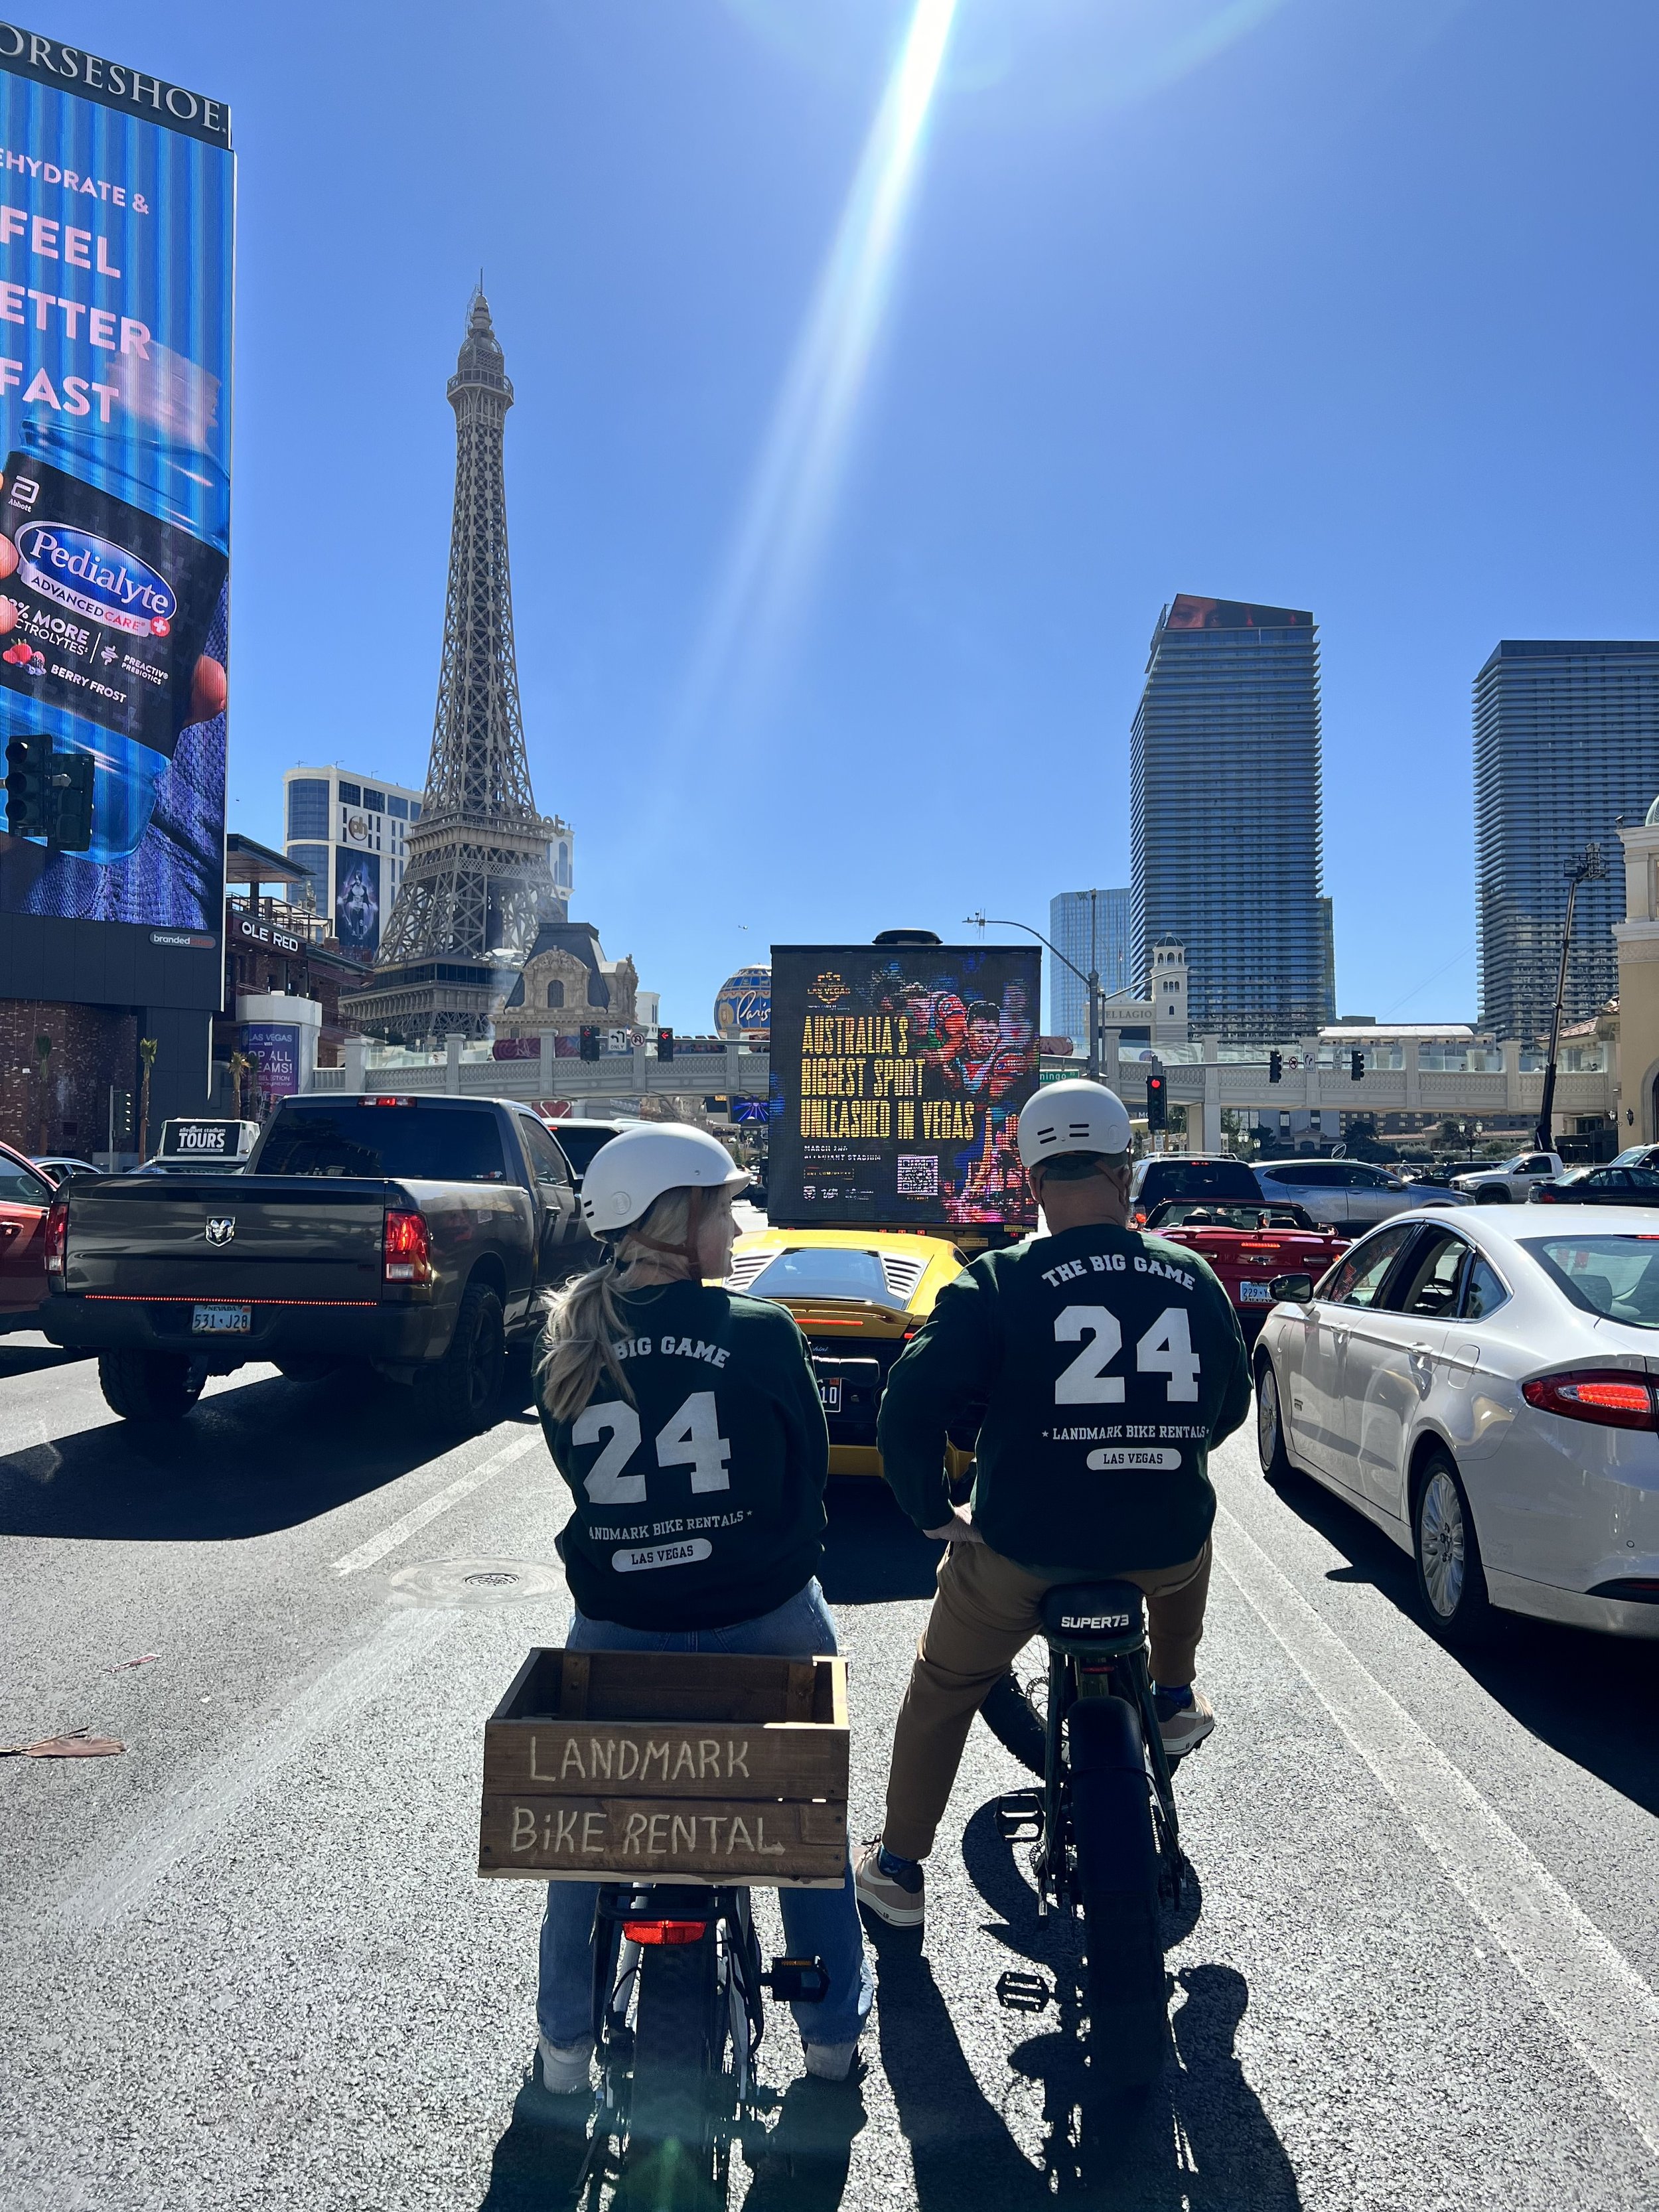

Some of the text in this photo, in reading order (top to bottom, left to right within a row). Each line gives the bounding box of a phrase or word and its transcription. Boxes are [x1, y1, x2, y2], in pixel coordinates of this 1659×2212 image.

[0, 148, 149, 214] HYDRATE &
[0, 204, 121, 279] FEEL
[0, 280, 151, 360] ETTER
[0, 357, 119, 423] FAST
[8, 498, 32, 512] Abbott
[30, 529, 169, 615] Pedialyte
[33, 609, 90, 644] MORE
[50, 664, 127, 703] BERRY FROST
[121, 662, 162, 685] PREBIOTICS
[242, 921, 298, 952] OLE RED
[737, 990, 771, 1025] Paris
[802, 1016, 908, 1055] AUSTRALIA'S
[269, 1051, 291, 1061] ALL
[801, 1058, 925, 1097] BIGGEST SPORT
[800, 1100, 975, 1140] UNLEASHED IN VEGAS
[179, 1132, 225, 1148] TOURS
[1041, 1254, 1195, 1291] THE BIG GAME
[613, 1336, 731, 1368] BIG GAME
[1054, 1305, 1200, 1404] 24
[572, 1391, 731, 1504] 24
[1052, 1426, 1206, 1440] LANDMARK BIKE RENTALS
[1103, 1453, 1163, 1465] LAS VEGAS
[653, 1519, 684, 1536] BIKE
[686, 1511, 744, 1530] RENTALS
[631, 1545, 694, 1565] LAS VEGAS
[1061, 1614, 1129, 1629] SUPER73
[531, 1736, 750, 1782] LANDMARK
[622, 1812, 786, 1856] RENTAL
